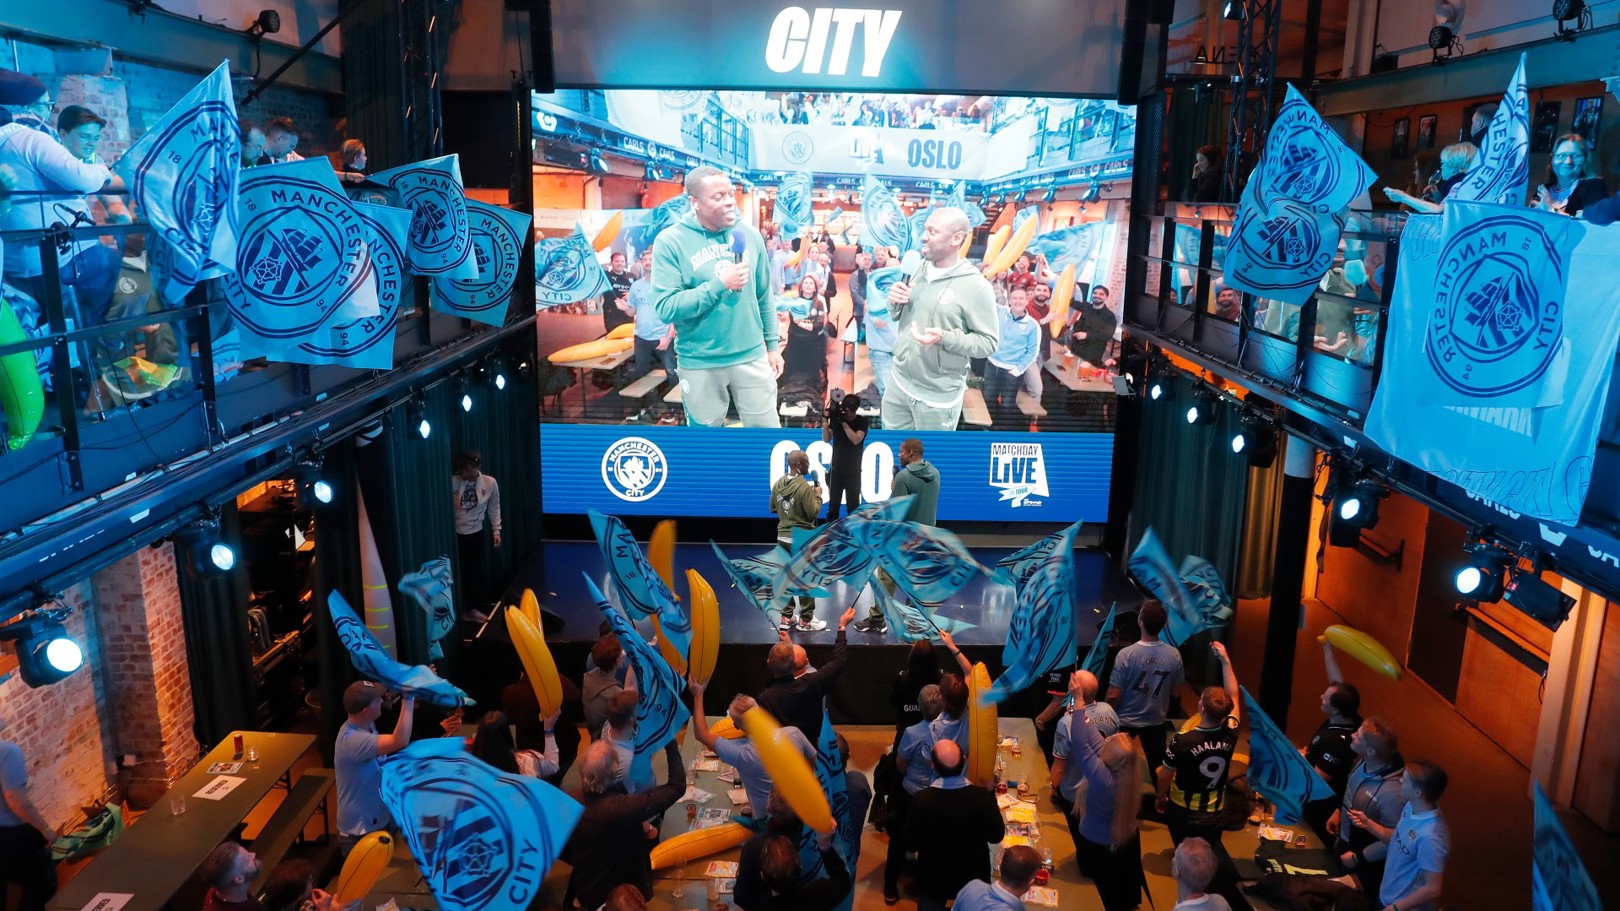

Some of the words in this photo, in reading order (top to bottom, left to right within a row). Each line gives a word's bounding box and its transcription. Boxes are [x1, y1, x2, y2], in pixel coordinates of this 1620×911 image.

[765, 6, 903, 77] CITY
[908, 138, 962, 170] OSLO
[418, 176, 466, 253] MANCHESTER
[270, 189, 361, 287] MANCHESTER
[481, 218, 515, 299] MANCHESTER
[361, 230, 397, 334] NCHESTER
[316, 299, 328, 313] 94
[339, 332, 350, 346] 94
[609, 442, 660, 462] MANCHESTER
[993, 445, 1039, 456] MATCHDAY
[625, 489, 645, 497] CITY
[625, 572, 636, 580] 18
[1131, 670, 1172, 699] 47
[654, 703, 667, 717] 94
[1199, 755, 1227, 789] 9
[508, 838, 540, 905] CITY
